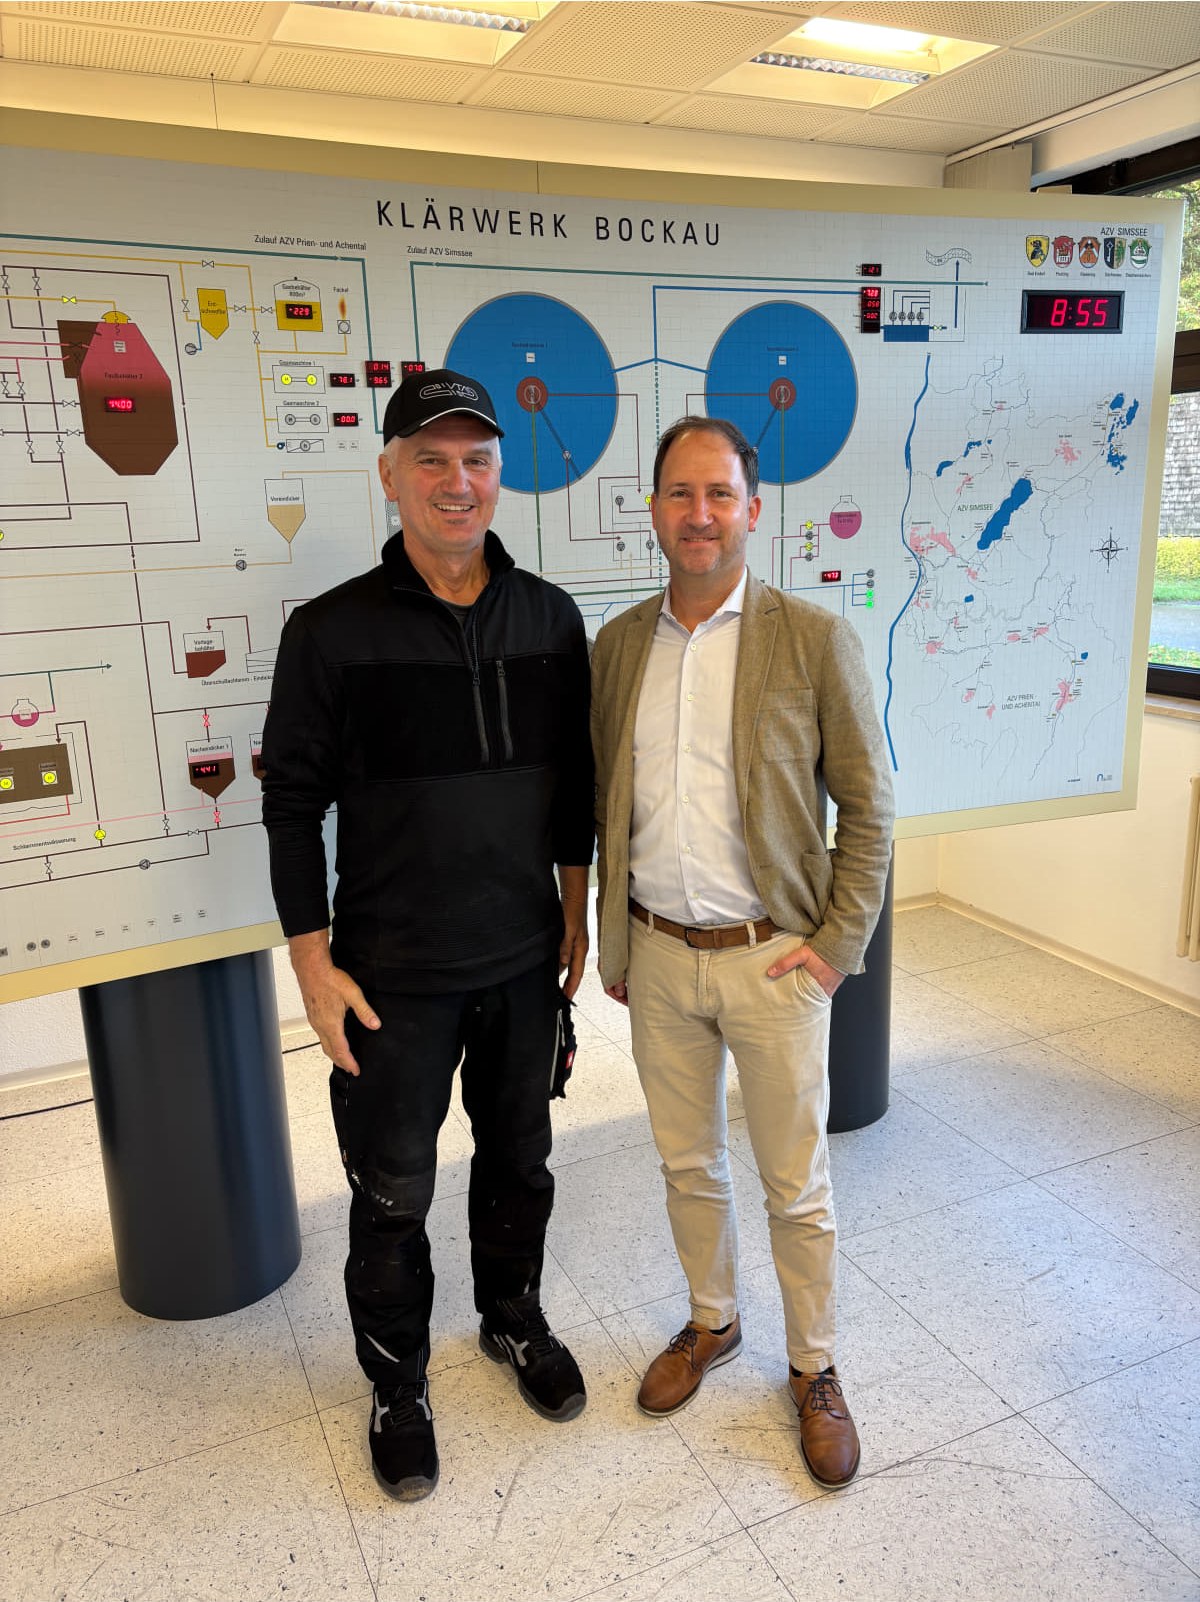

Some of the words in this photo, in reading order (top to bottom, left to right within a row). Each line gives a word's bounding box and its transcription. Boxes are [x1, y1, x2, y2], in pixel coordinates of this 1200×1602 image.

[377, 197, 568, 239] KLÄRWERK
[595, 216, 720, 246] BOCKAU
[1100, 227, 1114, 236] AZV
[1117, 227, 1148, 237] SIMSSEE
[254, 234, 278, 245] Zulauf
[279, 235, 295, 246] AZV
[296, 237, 318, 247] Prien-
[319, 239, 333, 248] und
[335, 240, 367, 251] Achental
[406, 245, 427, 255] Zulauf
[428, 246, 442, 256] AZV
[444, 247, 473, 257] Simssee
[1051, 298, 1108, 327] 8:55
